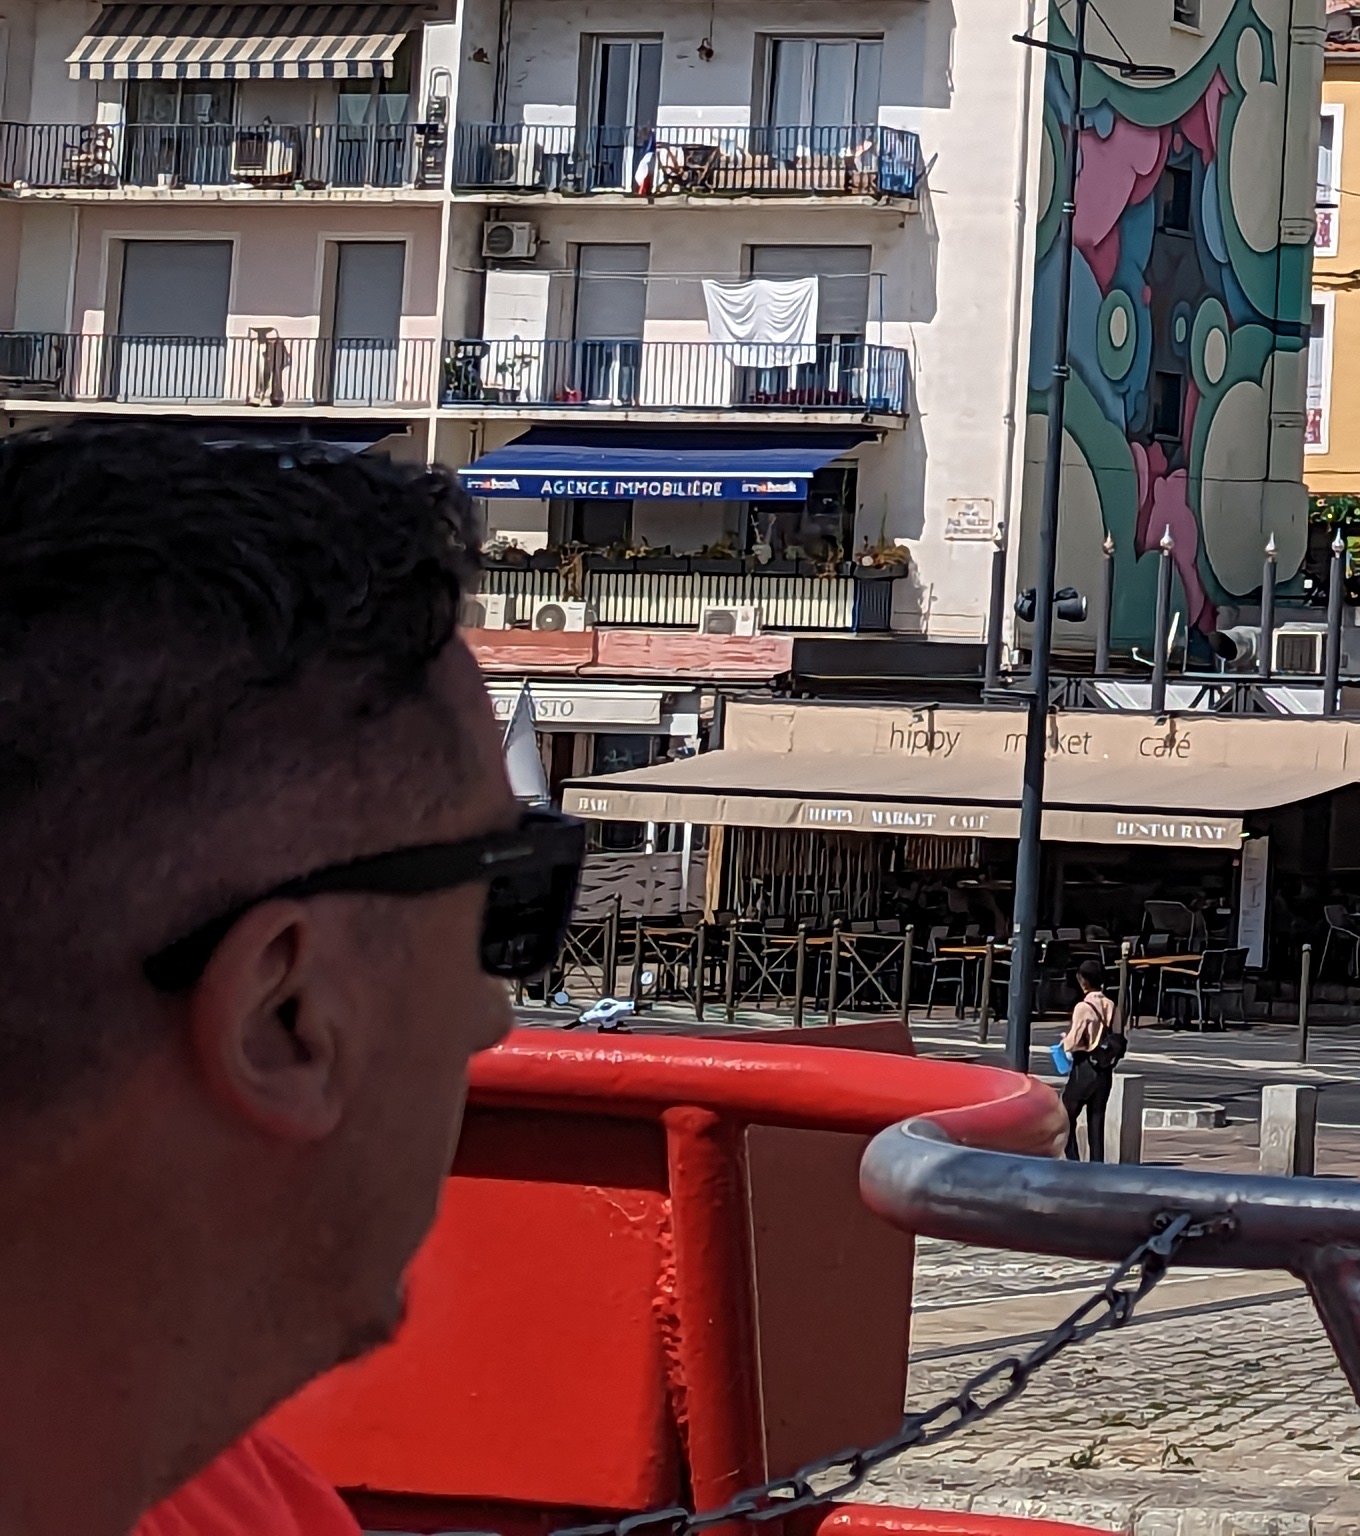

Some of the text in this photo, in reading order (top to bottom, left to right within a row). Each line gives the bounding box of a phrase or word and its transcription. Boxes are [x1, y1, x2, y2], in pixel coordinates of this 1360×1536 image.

[540, 479, 609, 496] AGENCE
[889, 721, 1192, 758] hippy mket café
[871, 809, 937, 828] MARKET
[1116, 821, 1227, 840] RESTAURANT
